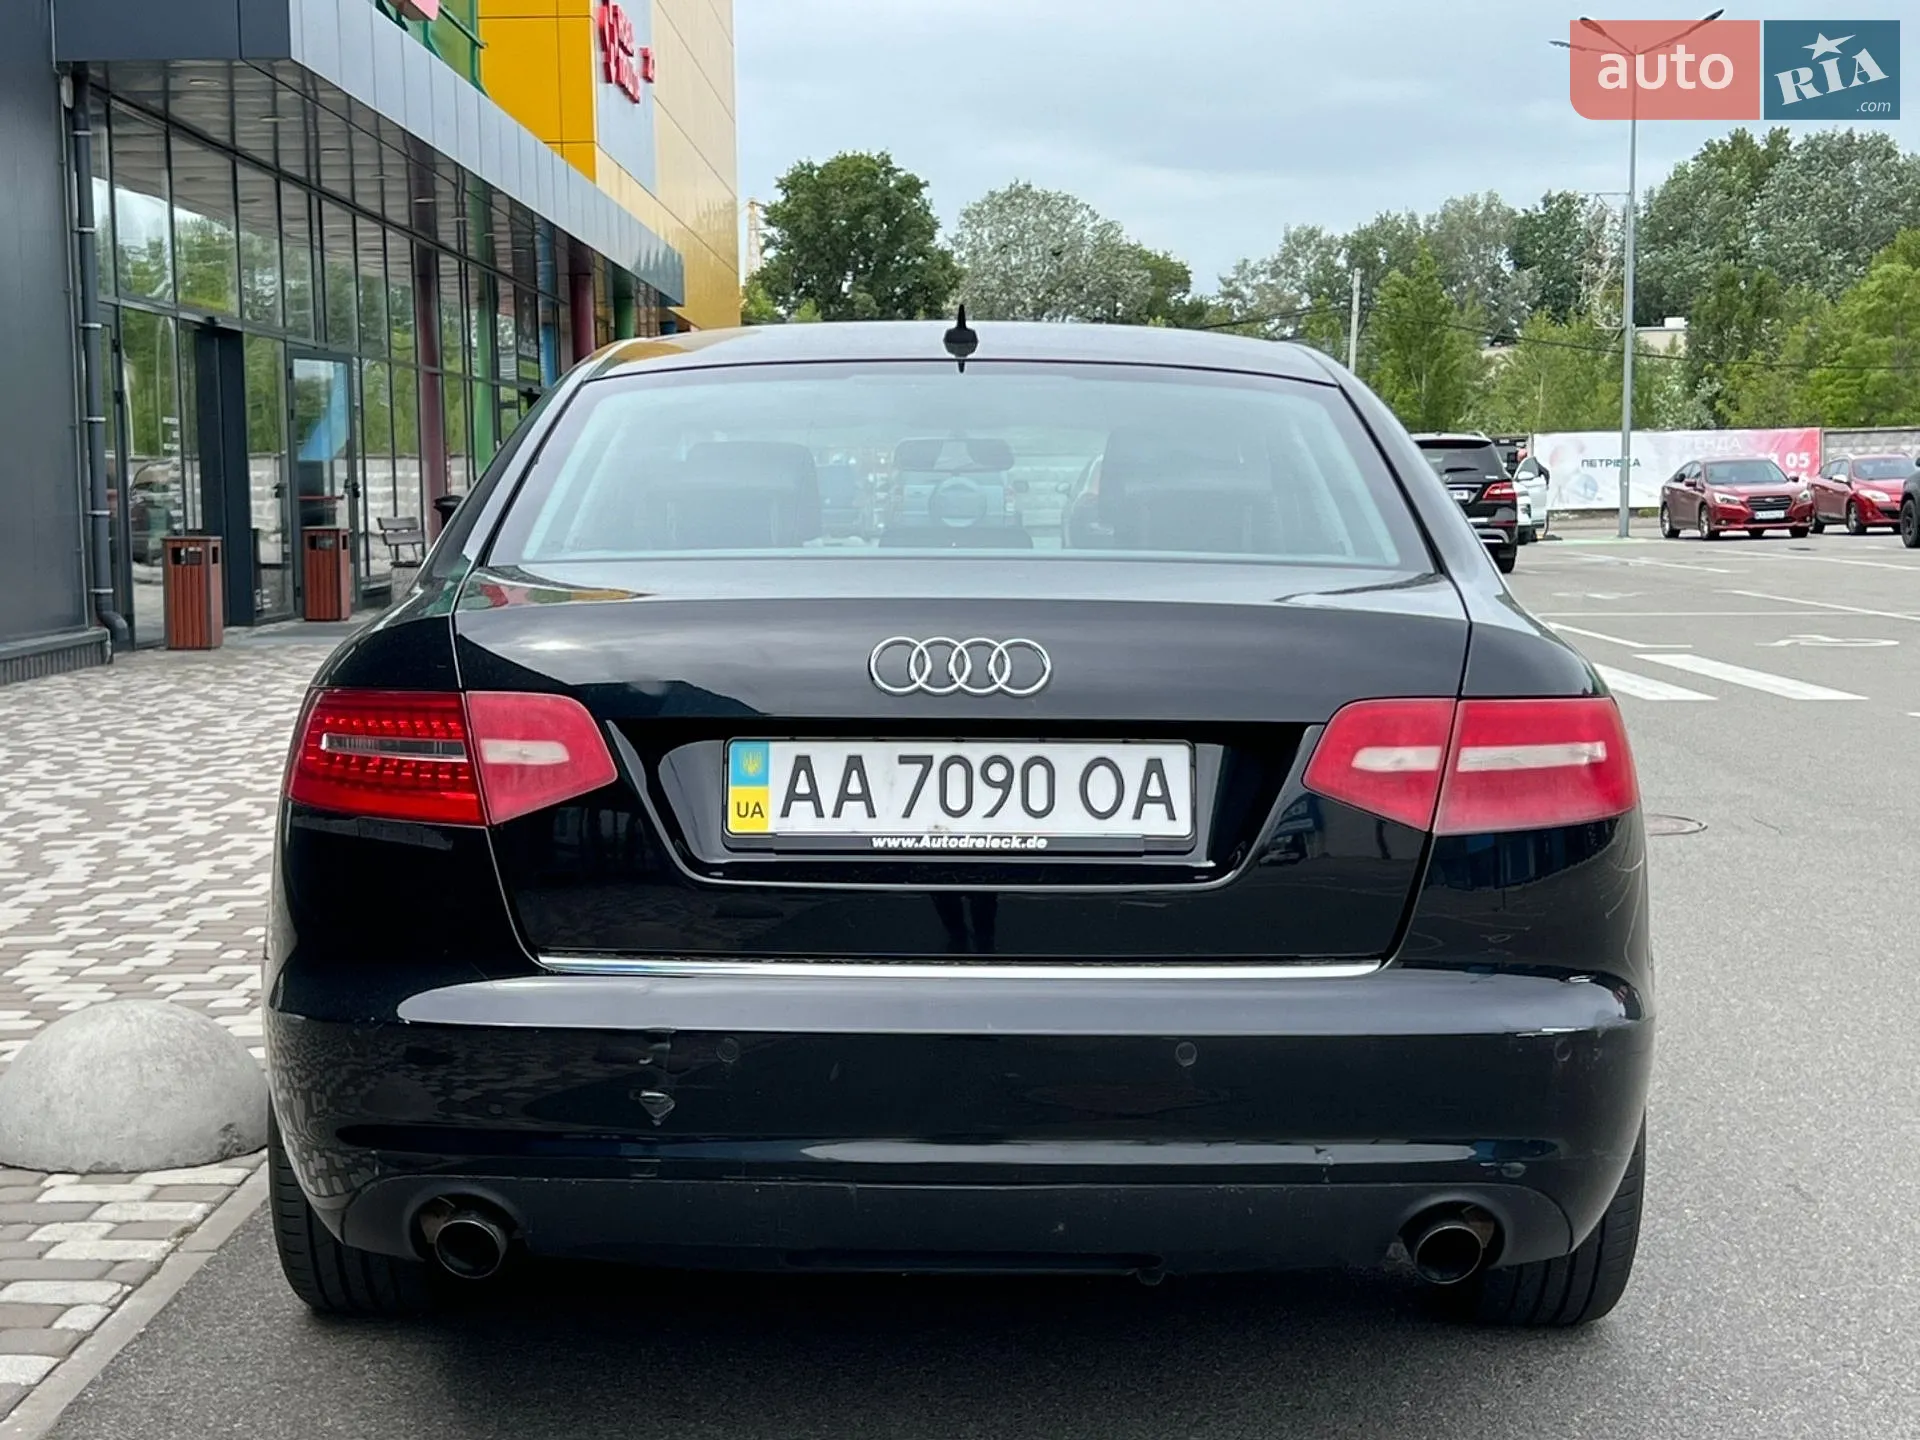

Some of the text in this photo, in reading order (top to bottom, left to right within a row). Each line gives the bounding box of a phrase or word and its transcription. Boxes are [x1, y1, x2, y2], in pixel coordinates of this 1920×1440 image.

[1785, 452, 1811, 469] 05
[779, 754, 1177, 821] AA 7090 OA
[736, 802, 765, 819] UA
